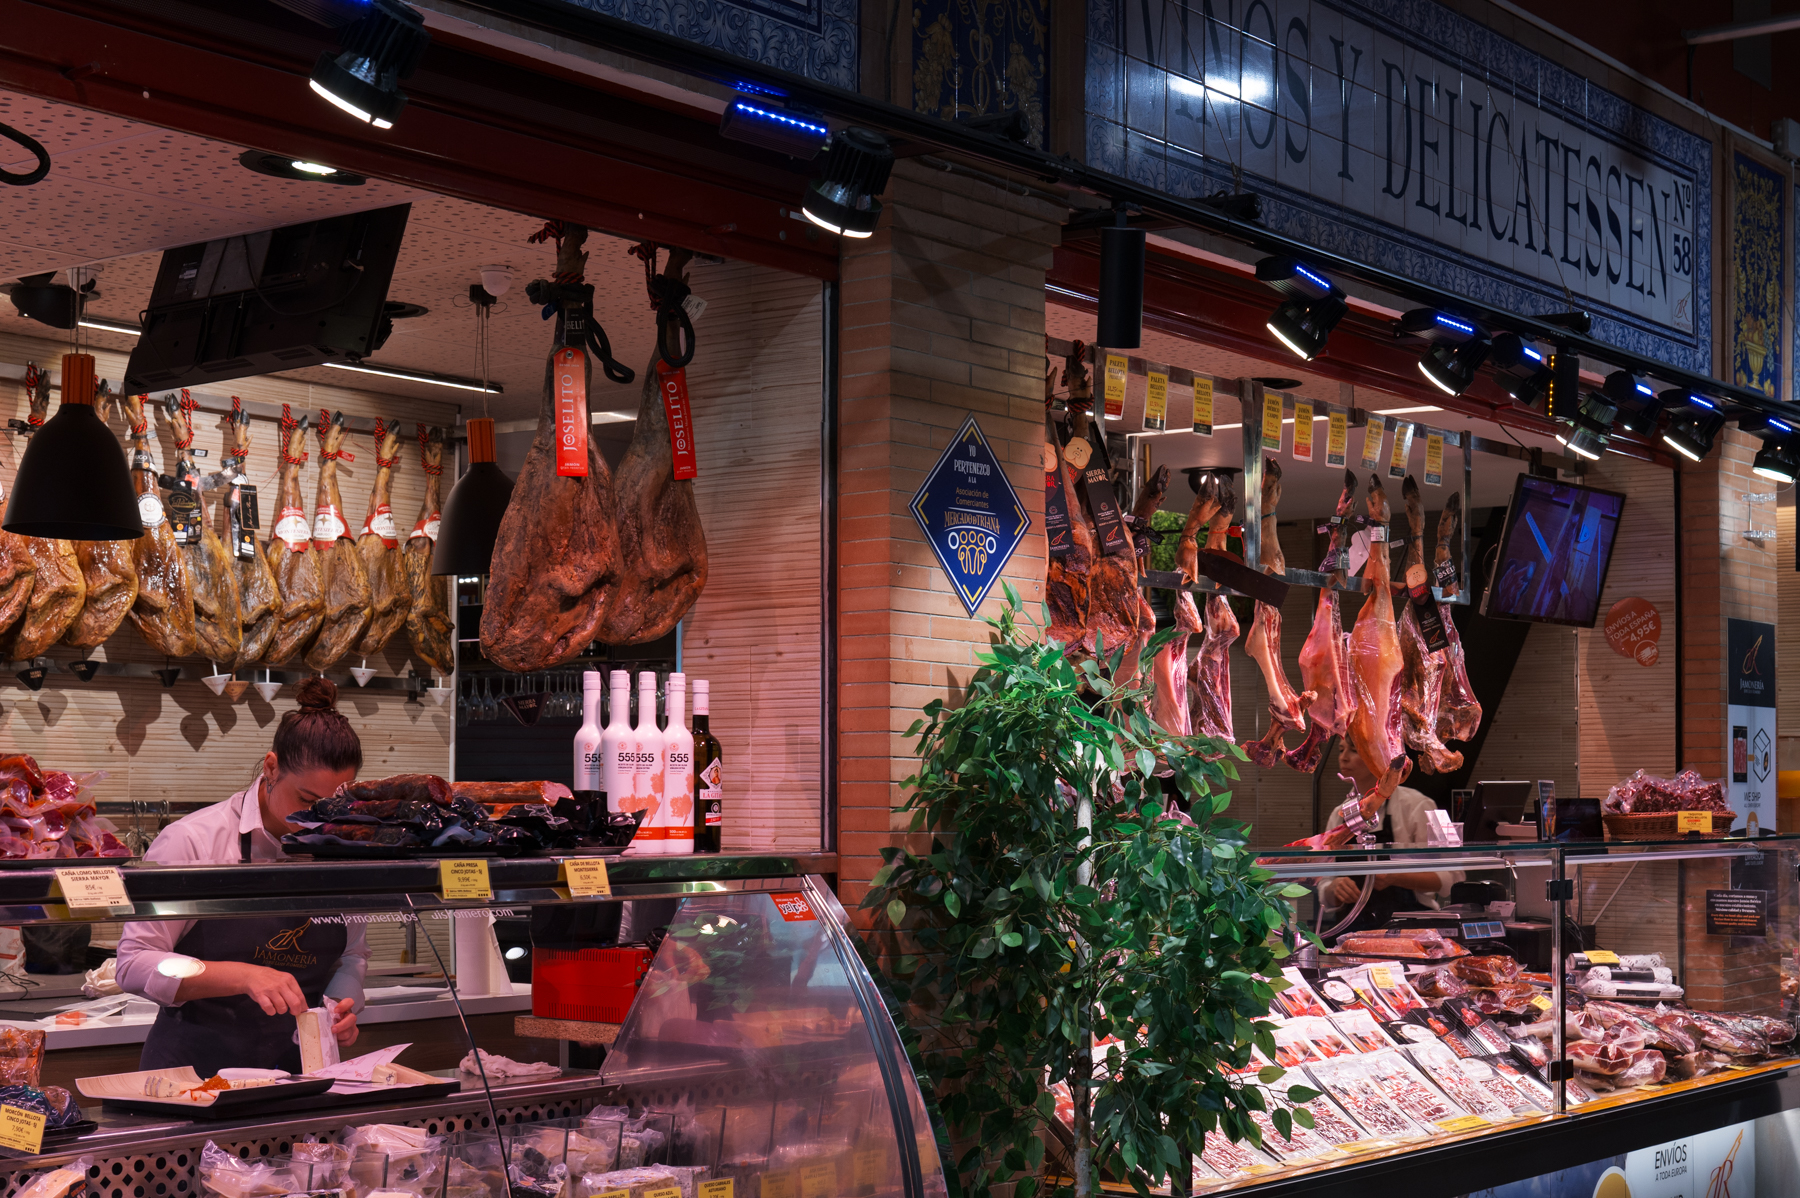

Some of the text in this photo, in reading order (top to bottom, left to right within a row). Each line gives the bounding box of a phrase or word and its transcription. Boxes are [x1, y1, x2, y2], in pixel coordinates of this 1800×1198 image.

[1329, 35, 1364, 182] Y
[1381, 58, 1671, 304] DELICATESSEN
[1674, 235, 1692, 277] 58
[969, 444, 976, 457] YO
[953, 459, 991, 476] PERTENEZCO
[1085, 468, 1106, 478] SIERRA
[1087, 475, 1109, 484] MAYOR
[956, 486, 989, 499] Asociación de
[956, 496, 990, 509] Comerciantes
[1605, 610, 1637, 634] ENVÍOS A
[1610, 610, 1656, 642] TODA ESPAÑA
[1630, 620, 1656, 642] 4,95€
[618, 752, 635, 762] 555
[636, 753, 655, 763] 555
[670, 753, 689, 763] 555
[778, 902, 800, 915] yelp
[253, 945, 318, 965] JAMONERÍA
[5, 1108, 41, 1122] MORCÓN BELLOTA
[6, 1115, 20, 1123] CINCO
[1655, 1141, 1688, 1170] ENVÍOS
[1659, 1169, 1671, 1181] TODA
[1671, 1165, 1688, 1179] EUROPA
